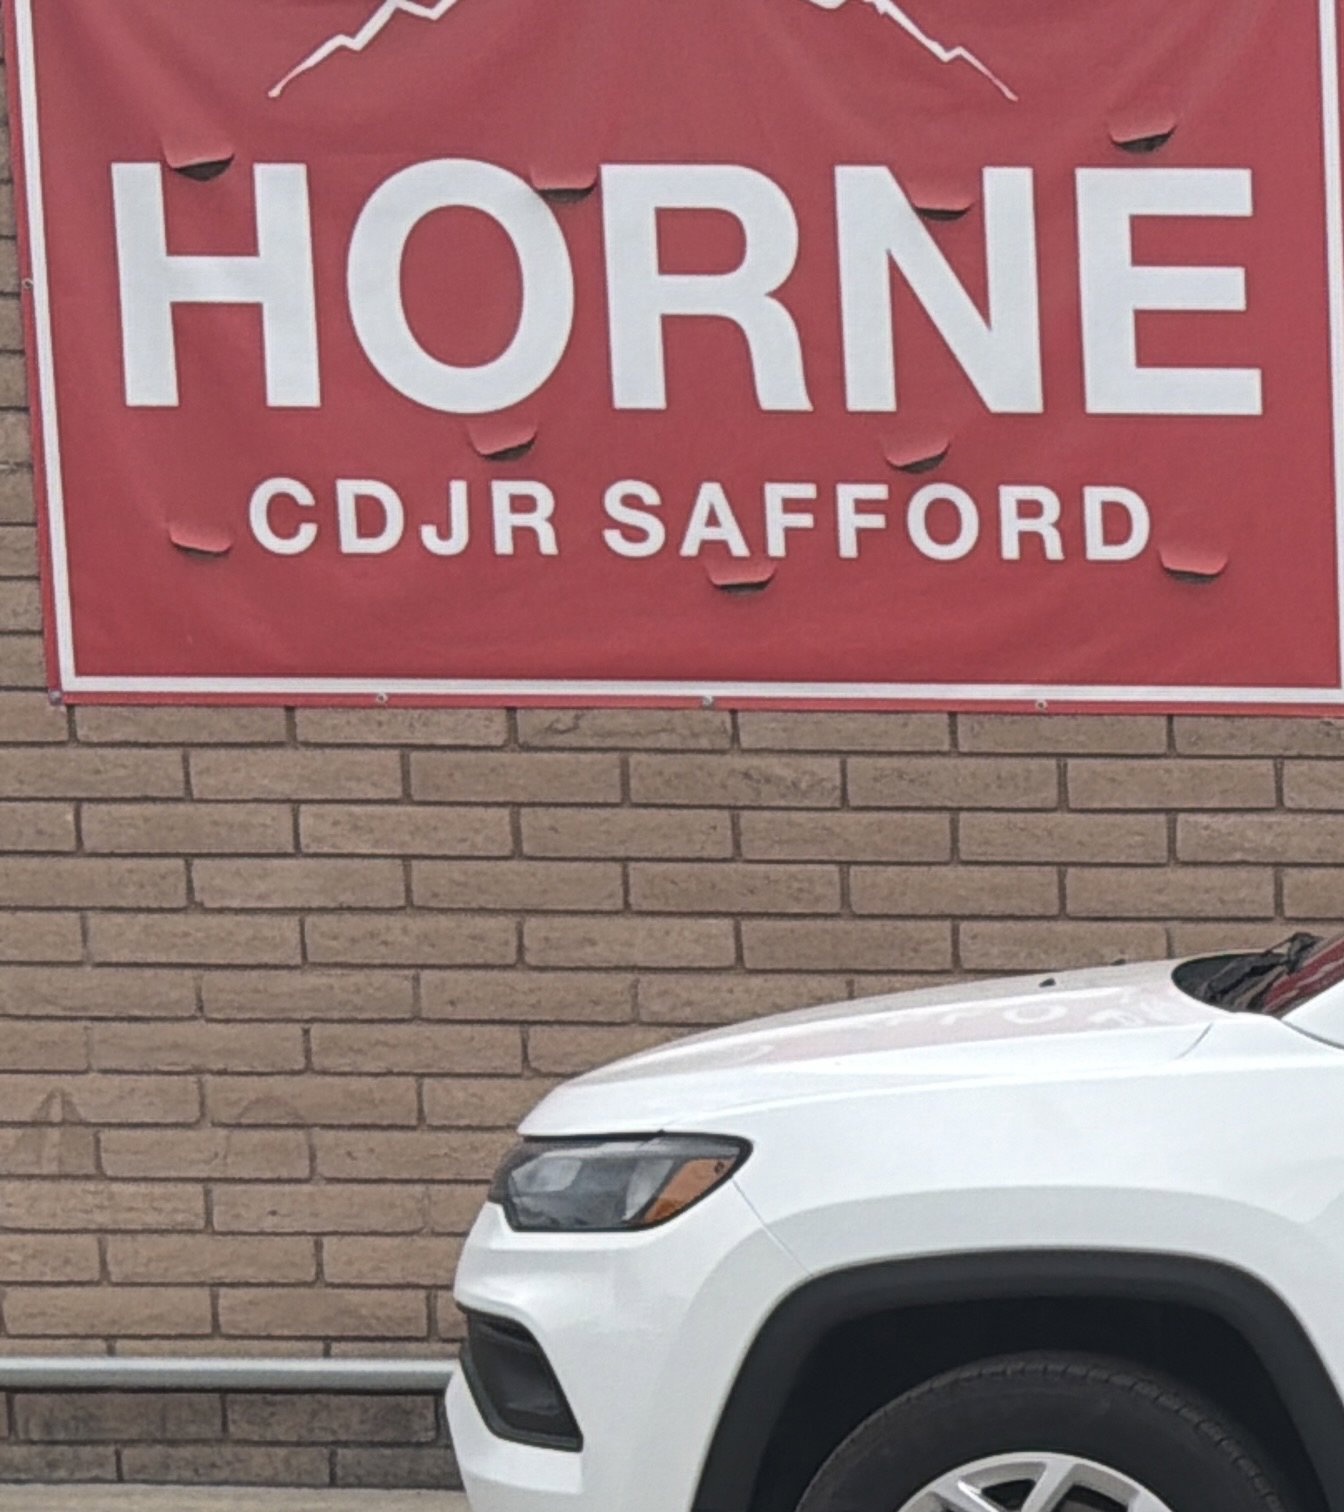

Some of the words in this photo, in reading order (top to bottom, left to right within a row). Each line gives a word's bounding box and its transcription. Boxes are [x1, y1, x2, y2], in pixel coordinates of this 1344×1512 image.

[110, 158, 1263, 416] HORNE
[249, 477, 558, 557] CDJR
[603, 479, 1151, 561] SAFFORD
